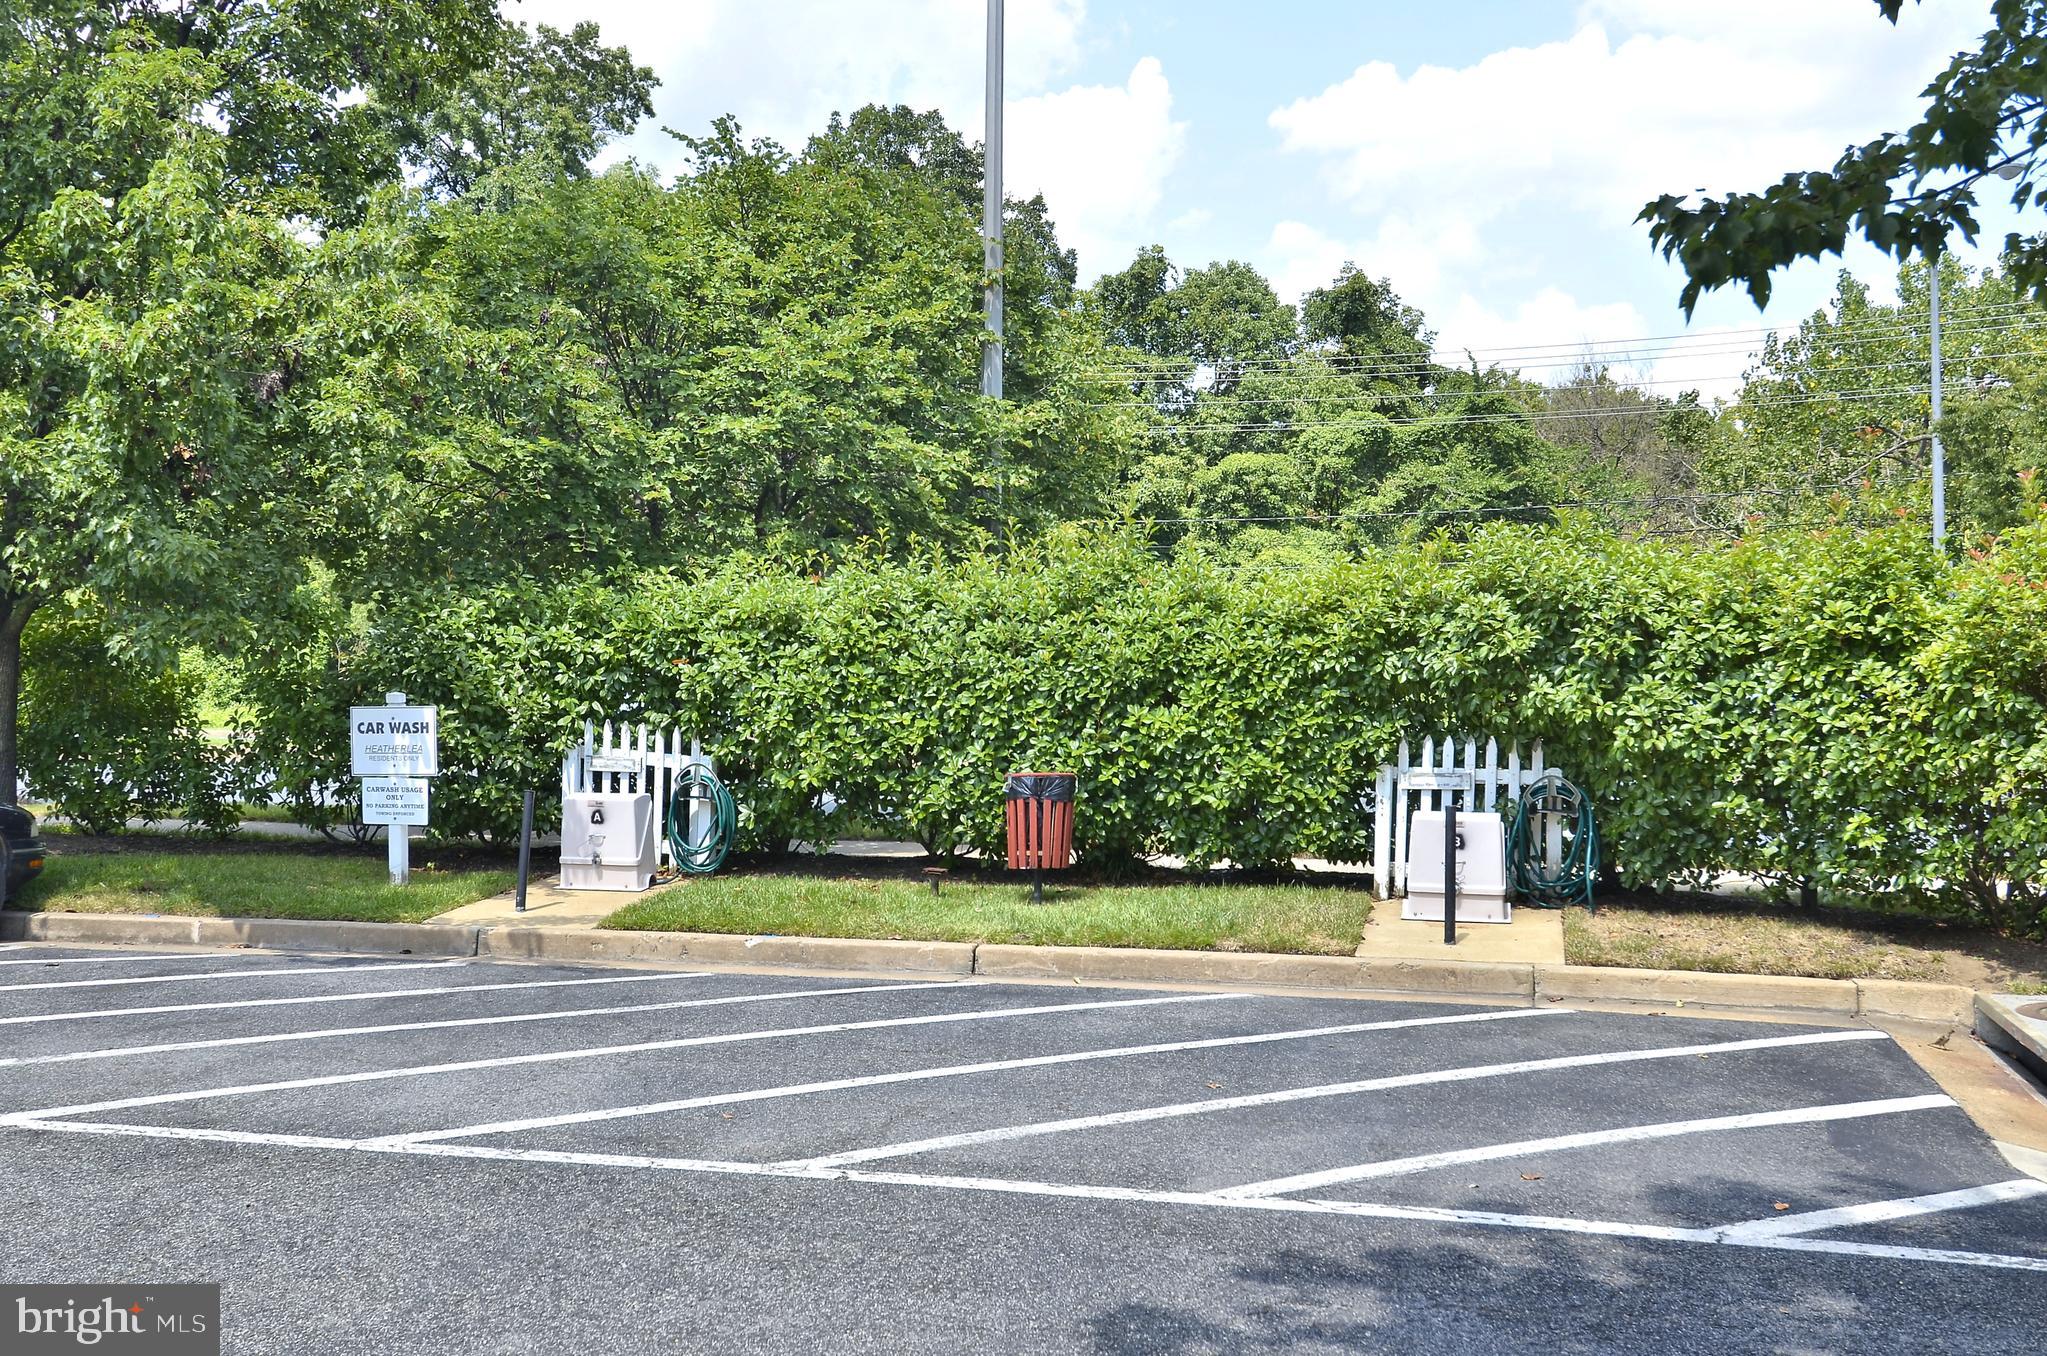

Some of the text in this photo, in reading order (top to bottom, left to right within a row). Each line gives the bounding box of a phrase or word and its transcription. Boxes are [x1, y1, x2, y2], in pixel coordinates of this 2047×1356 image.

[357, 722, 429, 734] CAR WASH
[365, 745, 423, 753] HEATHERLEA
